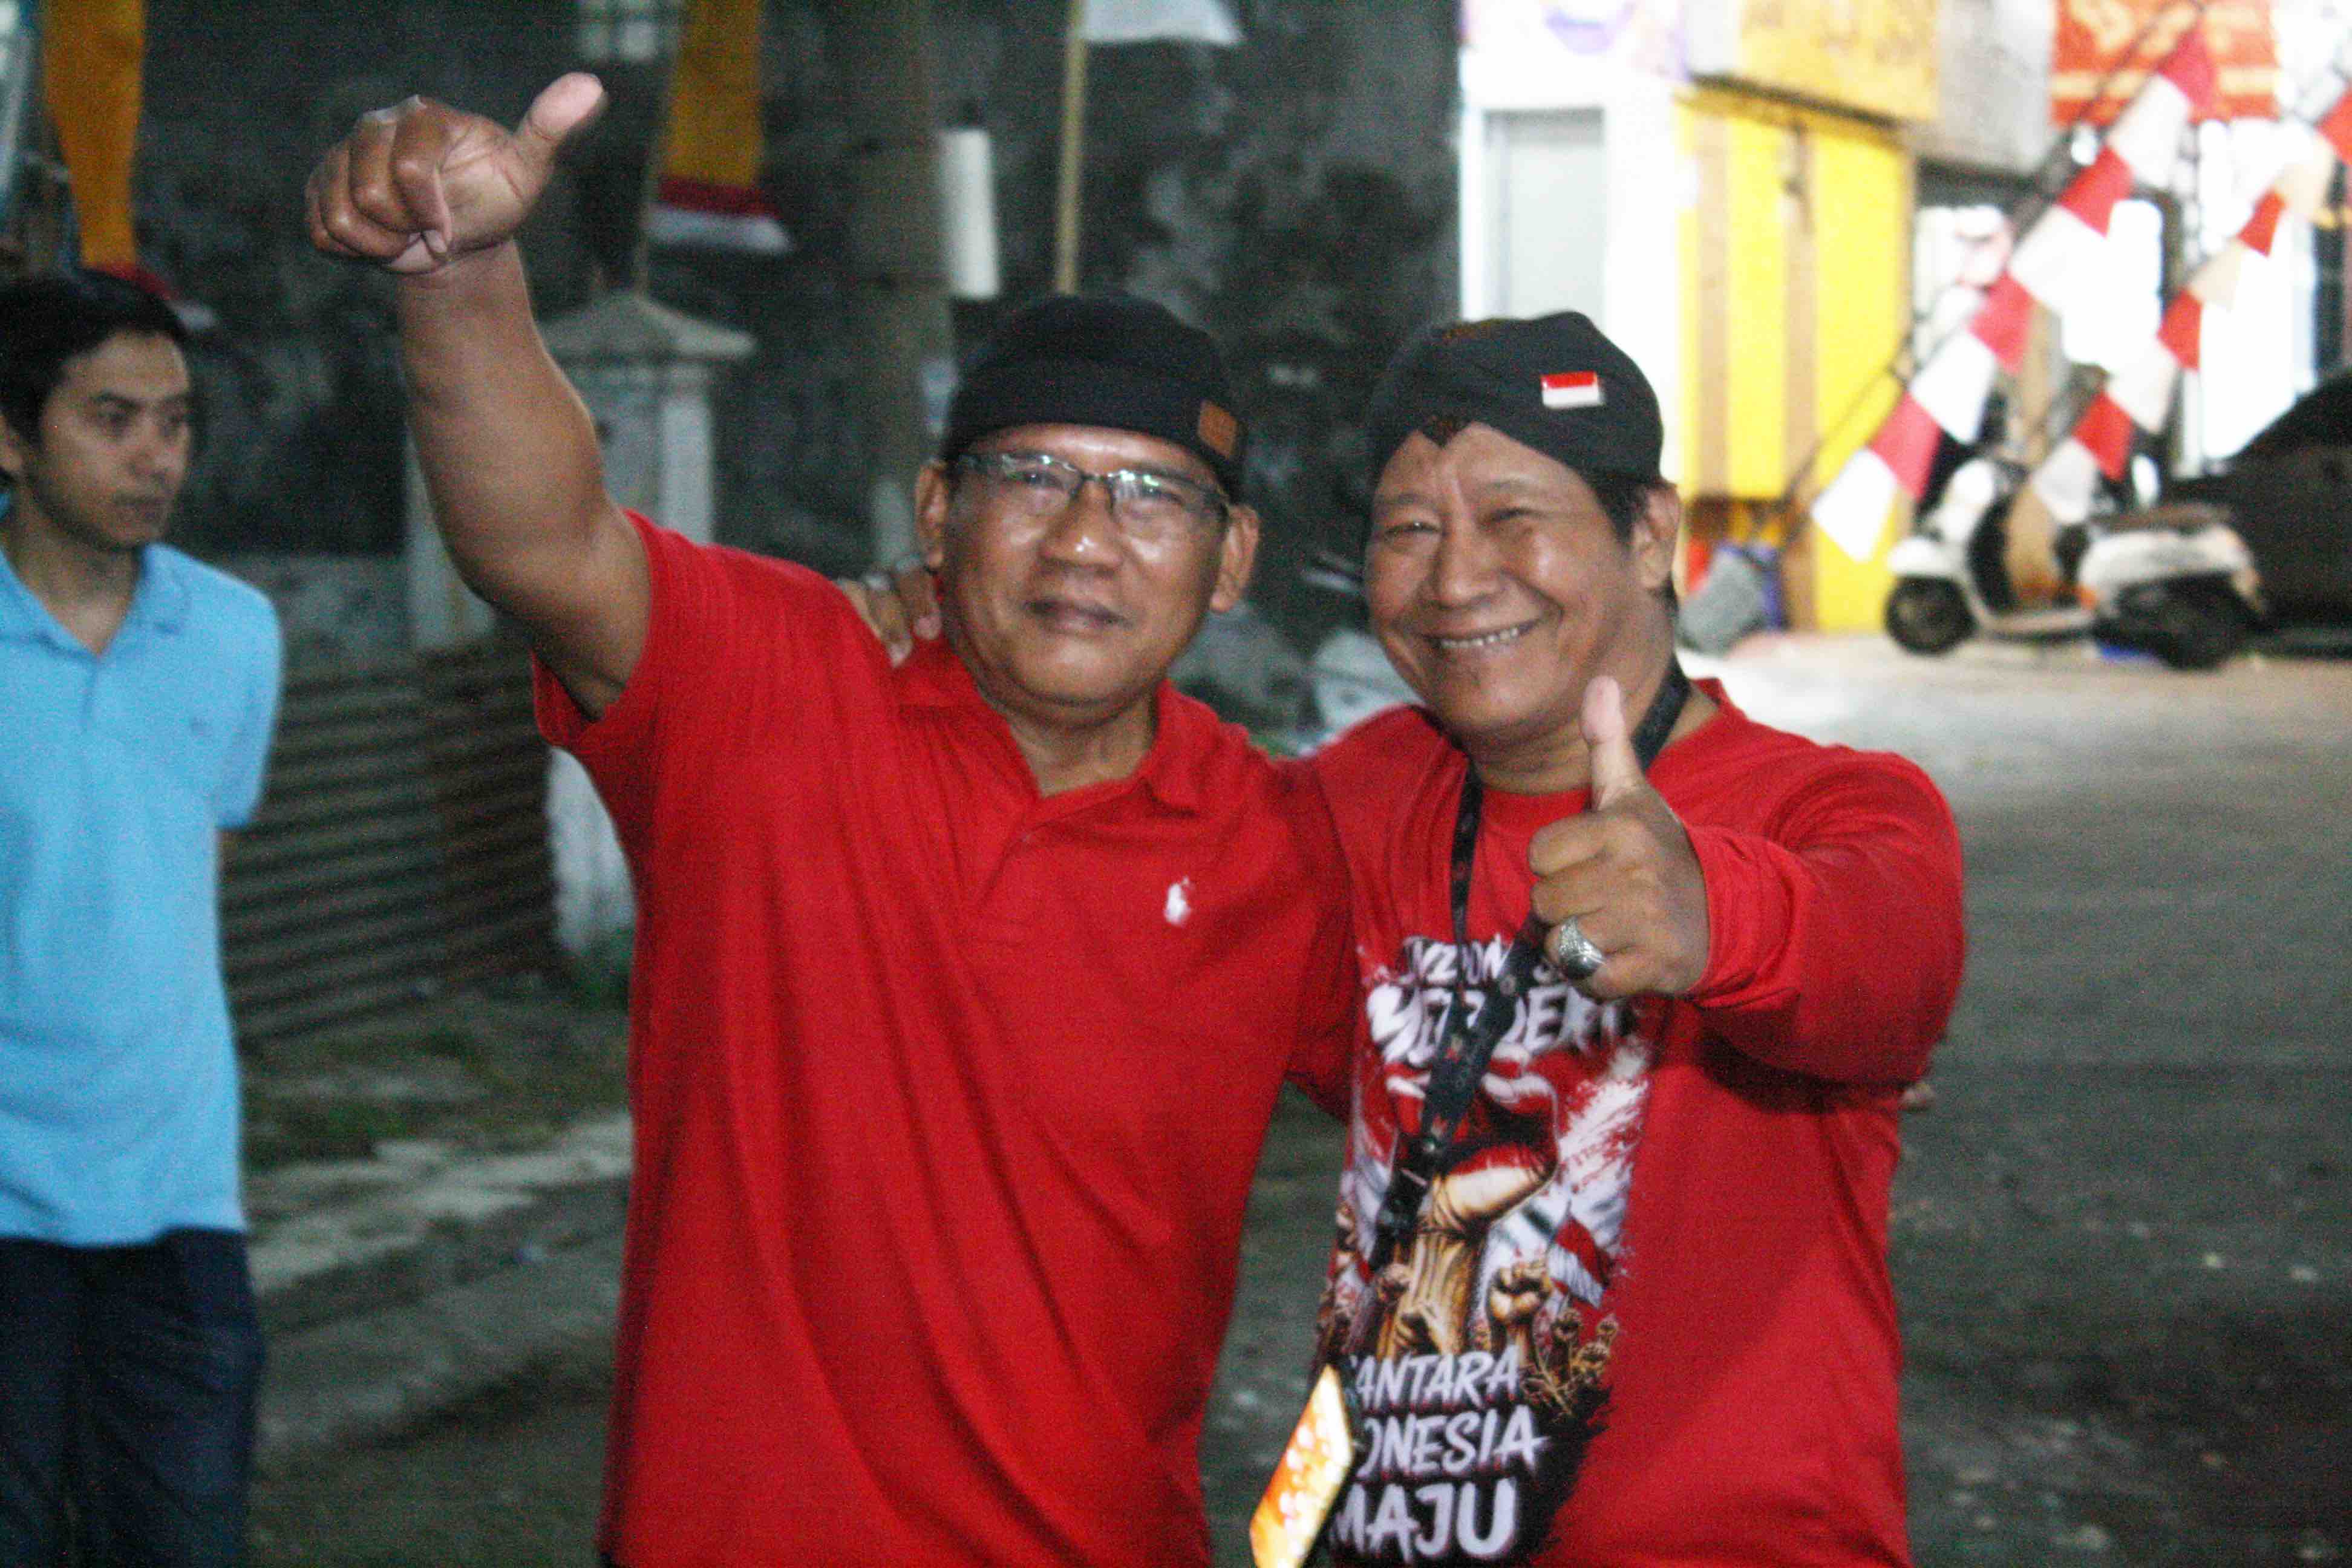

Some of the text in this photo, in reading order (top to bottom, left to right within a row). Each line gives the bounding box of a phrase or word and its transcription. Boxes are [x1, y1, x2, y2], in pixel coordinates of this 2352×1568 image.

[1349, 1344, 1521, 1410] ANTARA
[1356, 1403, 1549, 1477] ONESIA
[1331, 1476, 1516, 1564] MAJU
